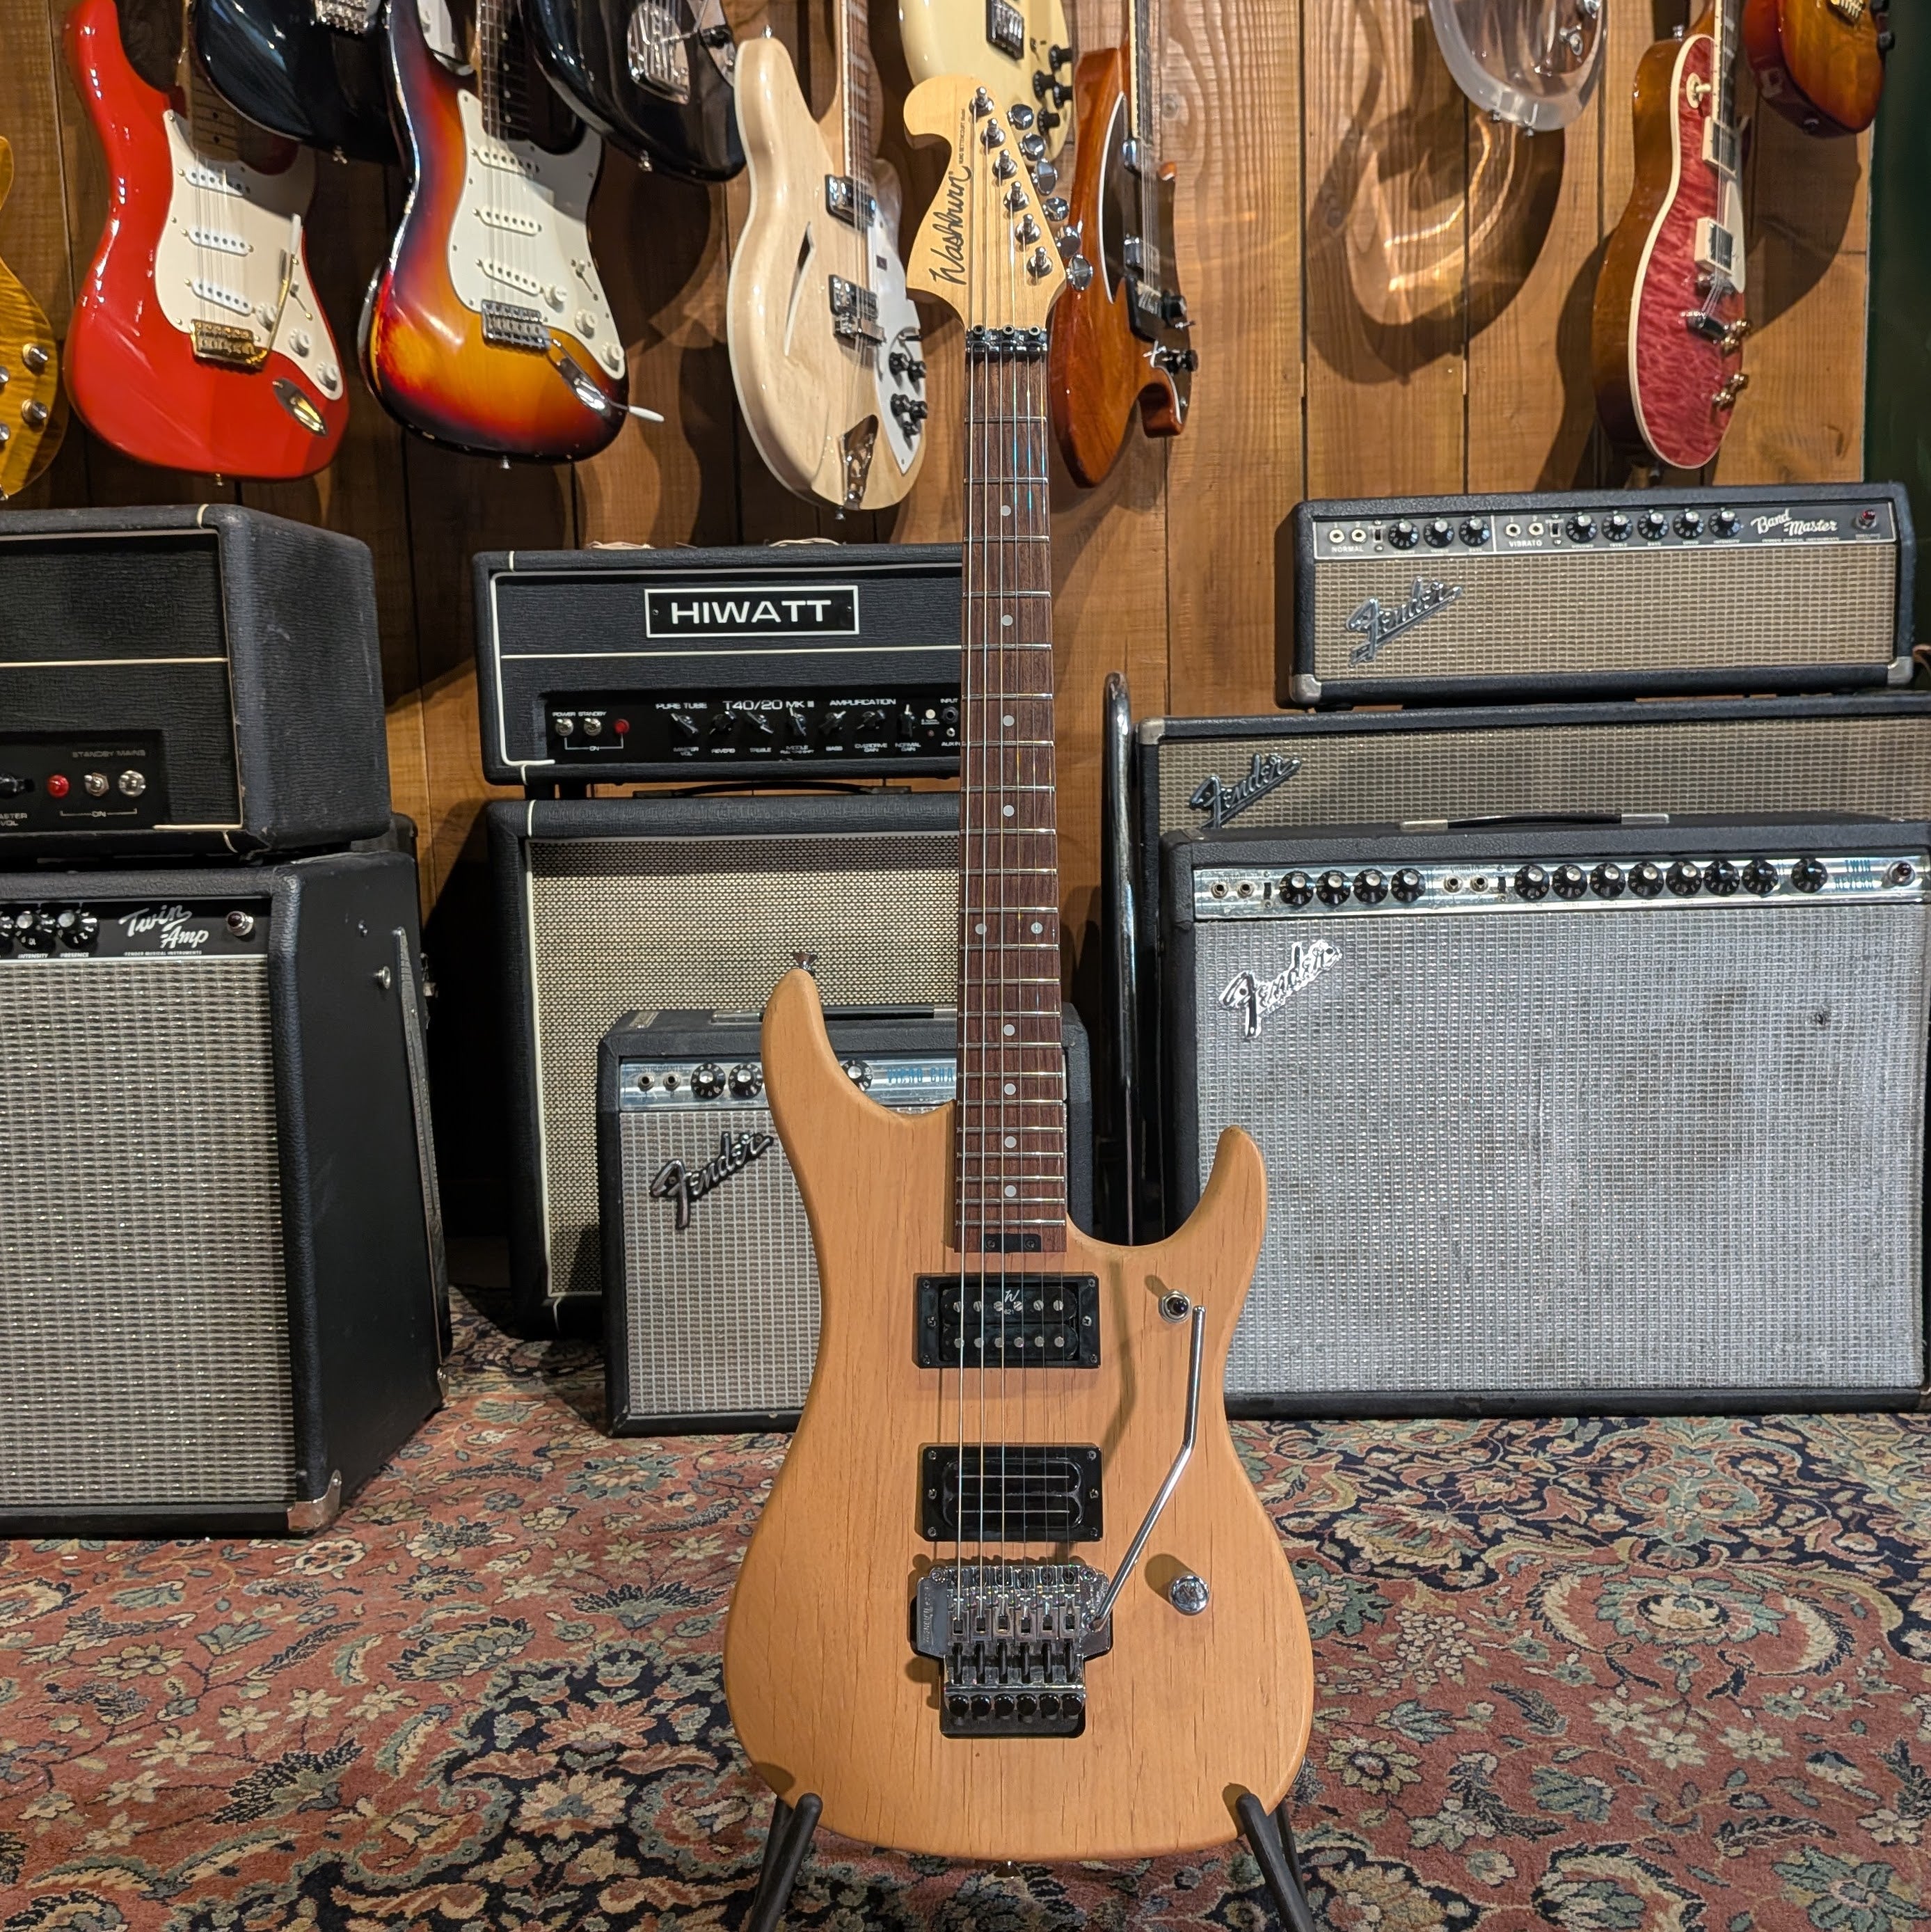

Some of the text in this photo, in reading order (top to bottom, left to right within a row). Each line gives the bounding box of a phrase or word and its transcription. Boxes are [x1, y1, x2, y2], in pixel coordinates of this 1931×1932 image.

[929, 165, 972, 285] Washburn
[1751, 508, 1838, 537] Band Master
[1509, 539, 1543, 548] VIBRATO
[671, 599, 832, 624] HIWATT
[1346, 576, 1463, 666] Fender
[722, 699, 783, 711] T40/20
[786, 700, 805, 708] MK
[1189, 752, 1301, 829] Fender
[118, 905, 193, 937] Twin
[160, 926, 209, 949] Amp
[1219, 940, 1342, 1038] Fender
[930, 1067, 956, 1082] CHA
[649, 1132, 773, 1229] Fender
